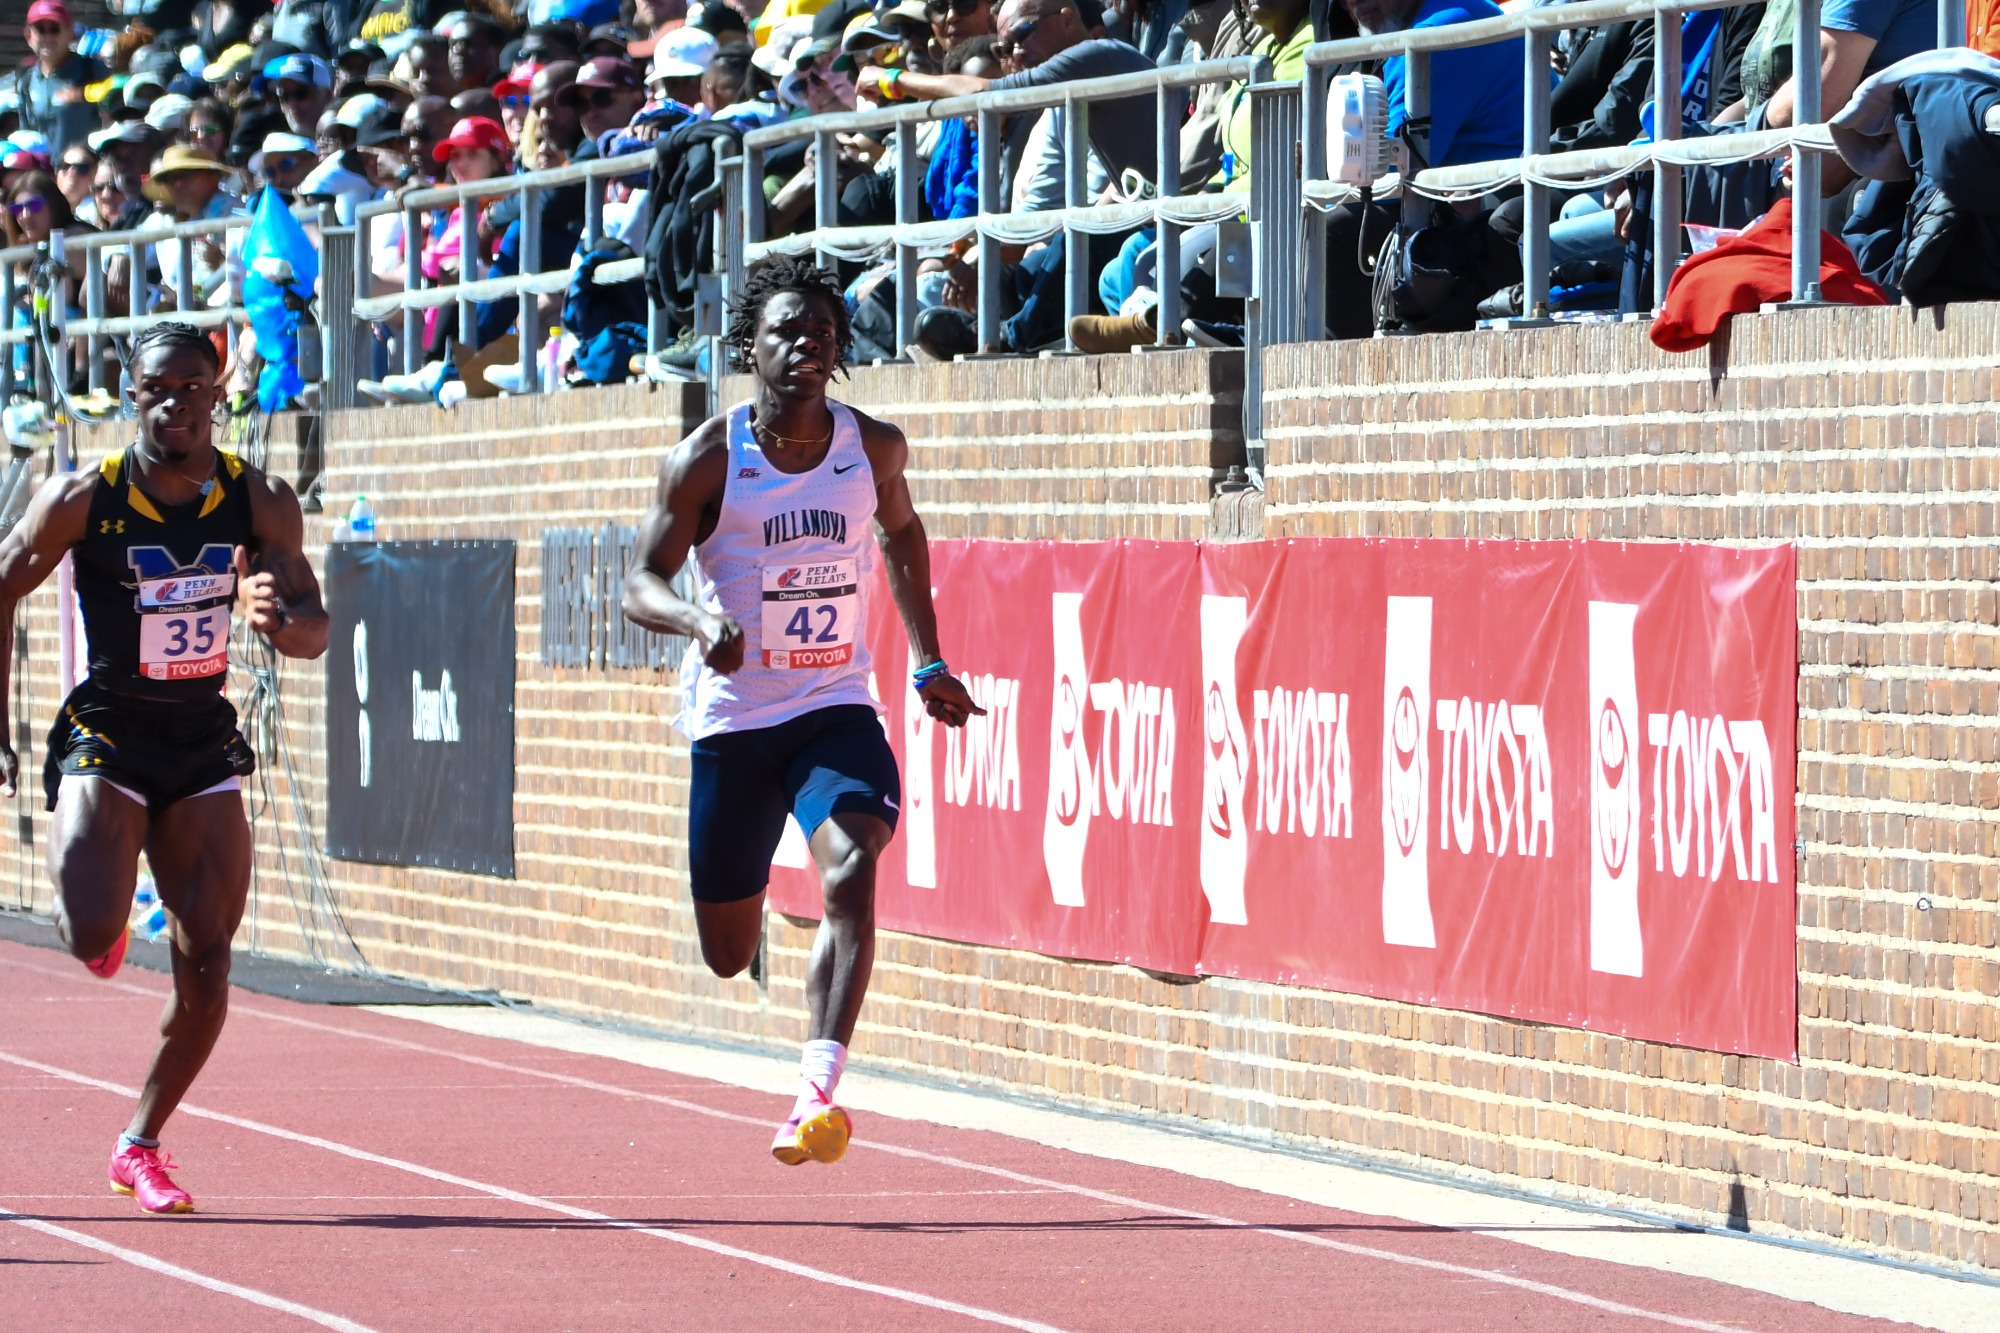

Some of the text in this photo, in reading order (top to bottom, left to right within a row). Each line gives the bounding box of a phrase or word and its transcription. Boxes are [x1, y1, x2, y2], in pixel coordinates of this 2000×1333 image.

[763, 509, 846, 547] VILLANOVA
[184, 579, 216, 590] PENN
[805, 573, 846, 586] RELAYS
[807, 565, 838, 576] PENN
[183, 586, 223, 599] RELAYS
[779, 590, 819, 600] Dream On.
[163, 615, 215, 657] 35
[785, 604, 839, 644] 42
[170, 658, 222, 676] TOYOTA
[793, 649, 847, 665] TOYOTA
[1090, 677, 1175, 826] TOYOTA
[1253, 685, 1352, 838] TOYOTA
[1437, 696, 1553, 857] TOYOTA
[1648, 710, 1779, 883] TOYOTA
